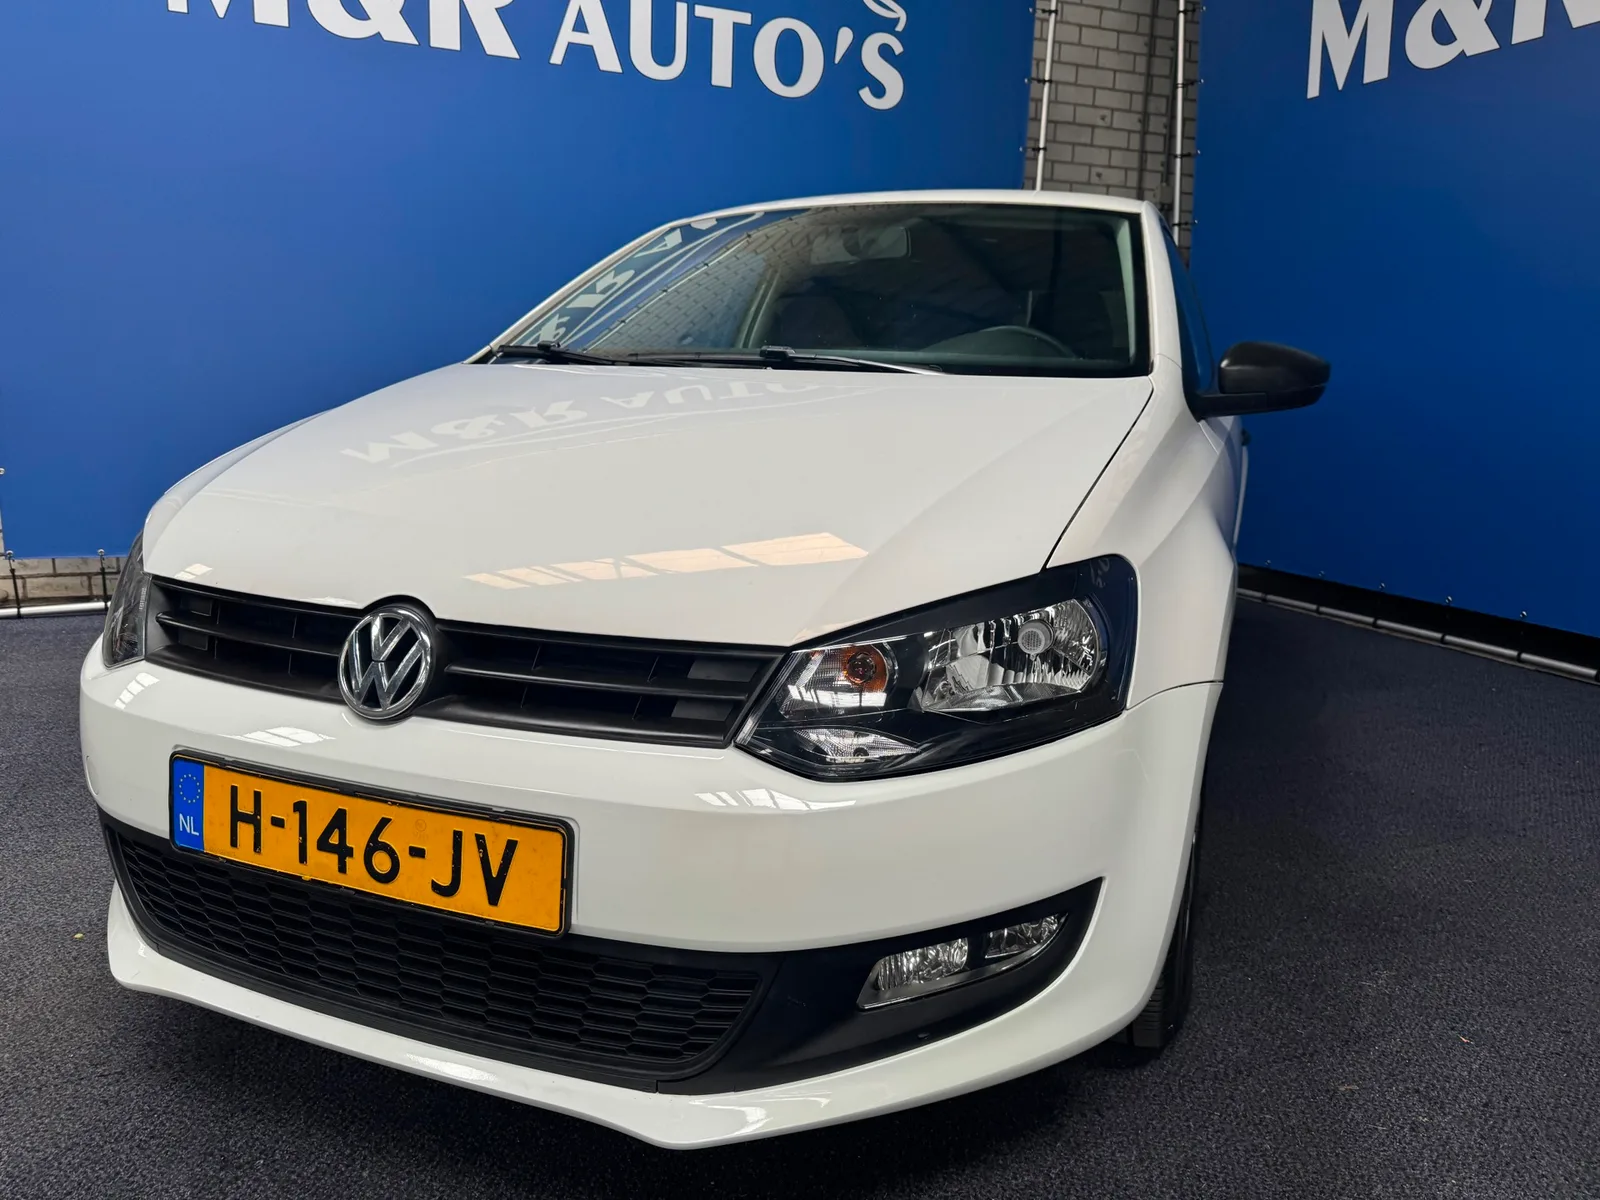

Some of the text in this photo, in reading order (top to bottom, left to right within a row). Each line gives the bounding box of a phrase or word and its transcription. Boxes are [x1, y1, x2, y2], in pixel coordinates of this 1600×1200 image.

[549, 0, 905, 111] AUTO'S
[179, 813, 200, 837] NL
[229, 784, 519, 907] H-146-JV
